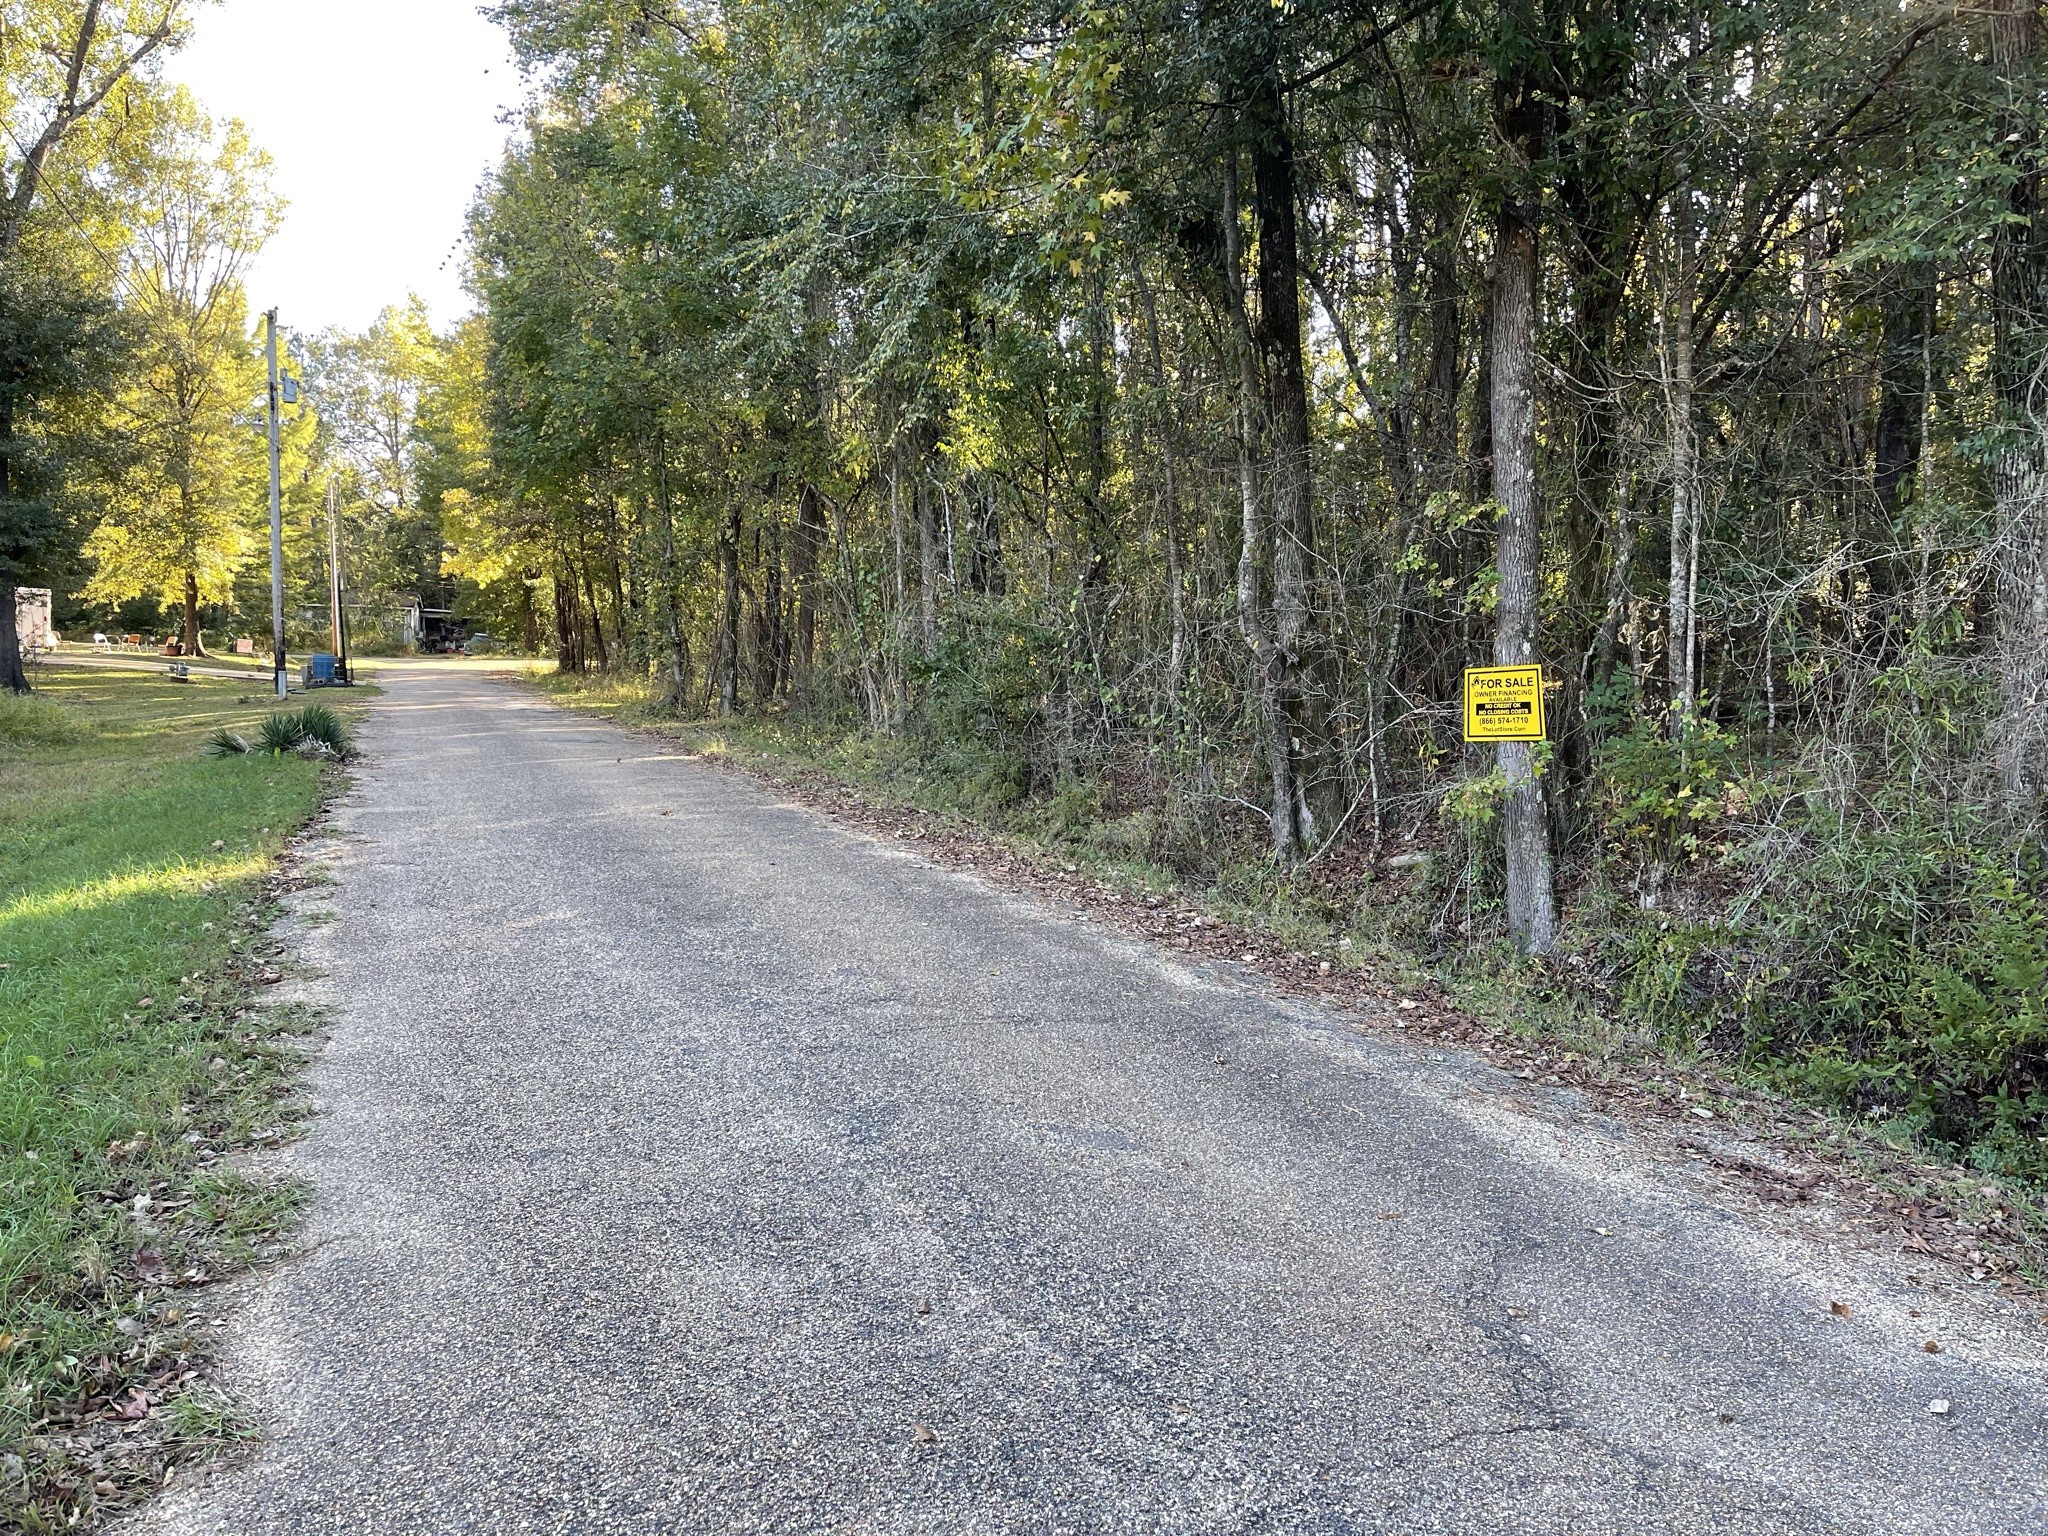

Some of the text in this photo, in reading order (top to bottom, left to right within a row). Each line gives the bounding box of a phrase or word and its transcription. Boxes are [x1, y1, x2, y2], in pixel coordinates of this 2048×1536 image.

[1480, 677, 1534, 689] FOR SALE
[1480, 717, 1529, 726] (866) 574-1710
